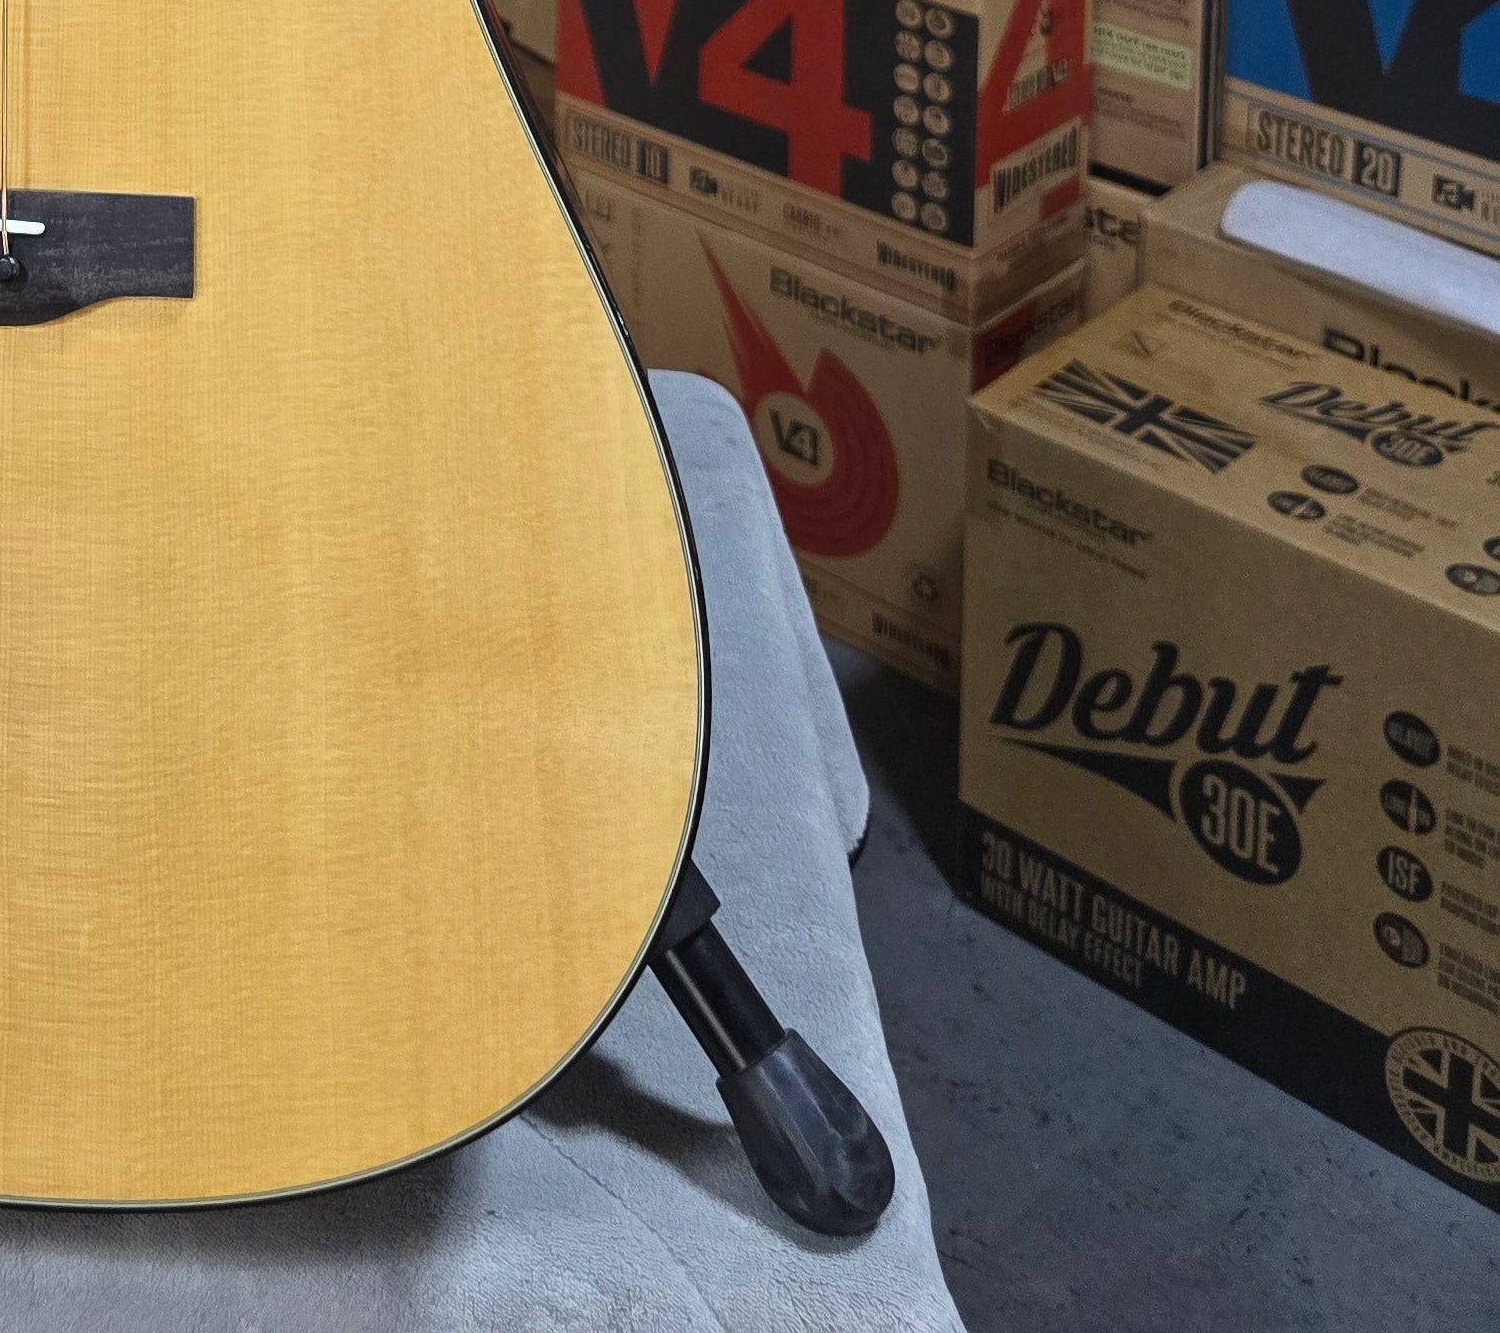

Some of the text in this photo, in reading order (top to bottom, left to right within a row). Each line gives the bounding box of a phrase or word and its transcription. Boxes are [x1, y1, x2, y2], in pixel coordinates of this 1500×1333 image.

[569, 116, 632, 168] STEREO
[1255, 110, 1345, 176] STEREO
[1361, 144, 1394, 194] 20
[770, 264, 938, 355] Blackstar
[1167, 298, 1317, 361] Blackstar
[1258, 381, 1500, 441] Debut
[986, 457, 1152, 547] Blackstar
[989, 620, 1344, 765] Debut
[1200, 772, 1282, 878] 30E
[1386, 850, 1423, 894] ISF
[1018, 851, 1085, 921] WATT
[1091, 893, 1181, 977] GUITAR
[1186, 948, 1248, 1010] AMP
[1083, 930, 1144, 989] EFFECT
